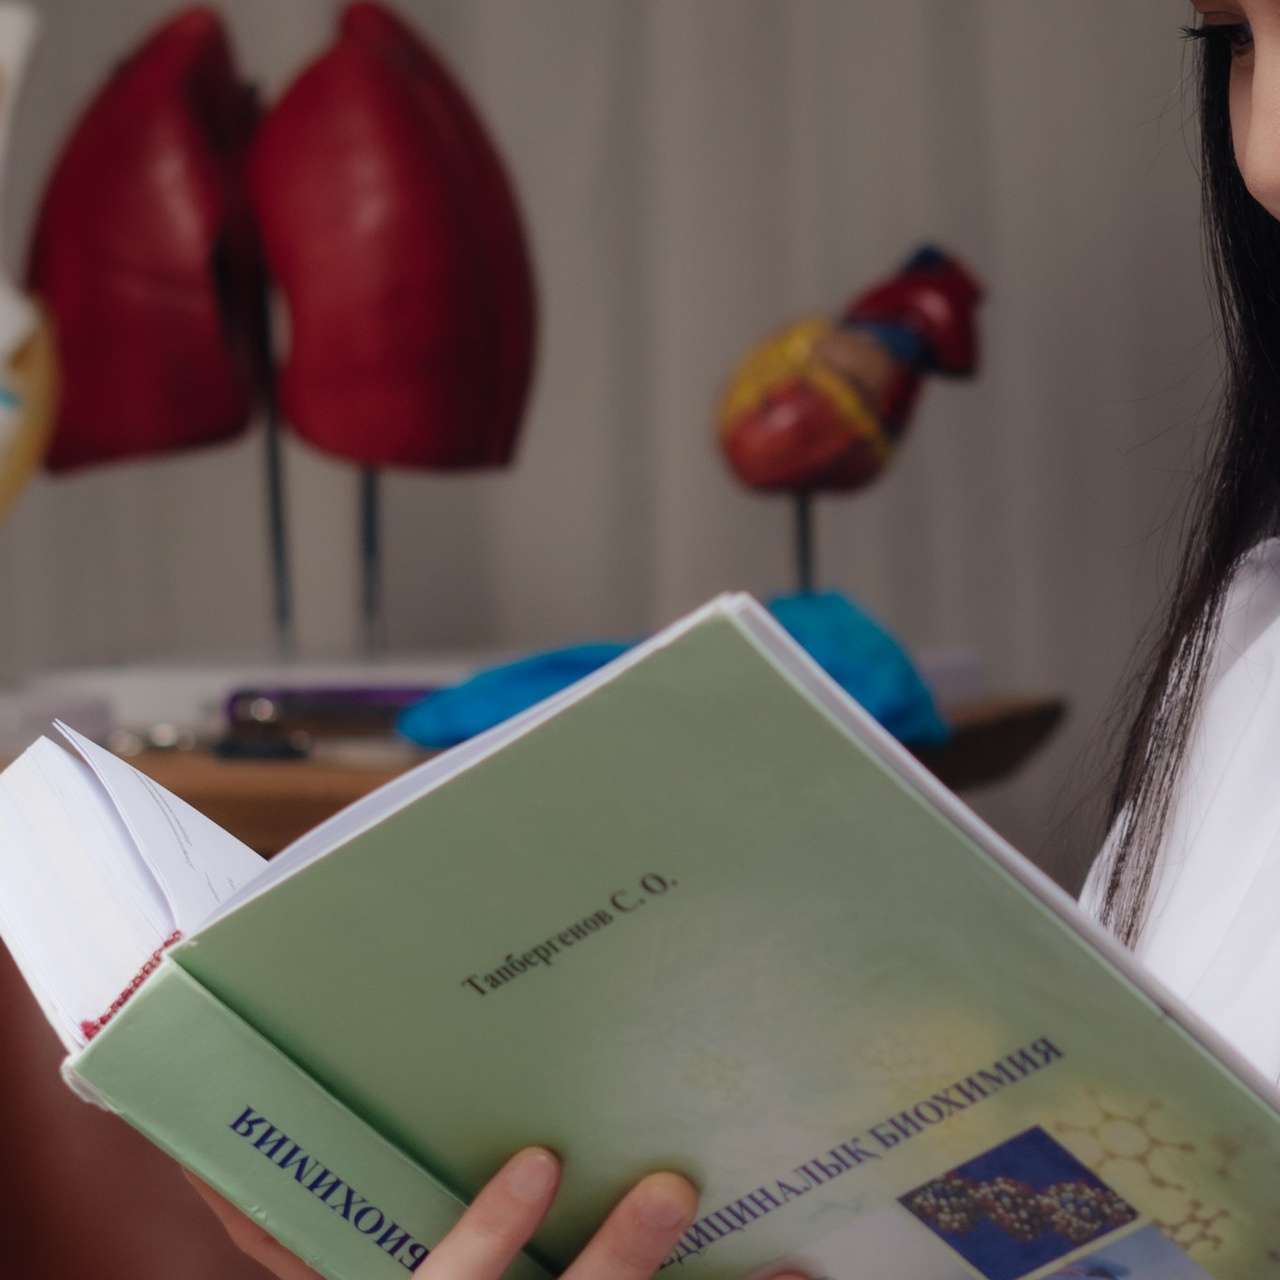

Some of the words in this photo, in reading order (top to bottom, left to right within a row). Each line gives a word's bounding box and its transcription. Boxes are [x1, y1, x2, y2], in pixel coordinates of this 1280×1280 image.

[610, 888, 645, 914] С.
[641, 871, 679, 899] О.
[228, 1104, 431, 1274] БИОХИМИЯ
[660, 1137, 882, 1272] ДИЦИНАЛЫҚ
[868, 1036, 1065, 1151] БИОХИМИЯ
